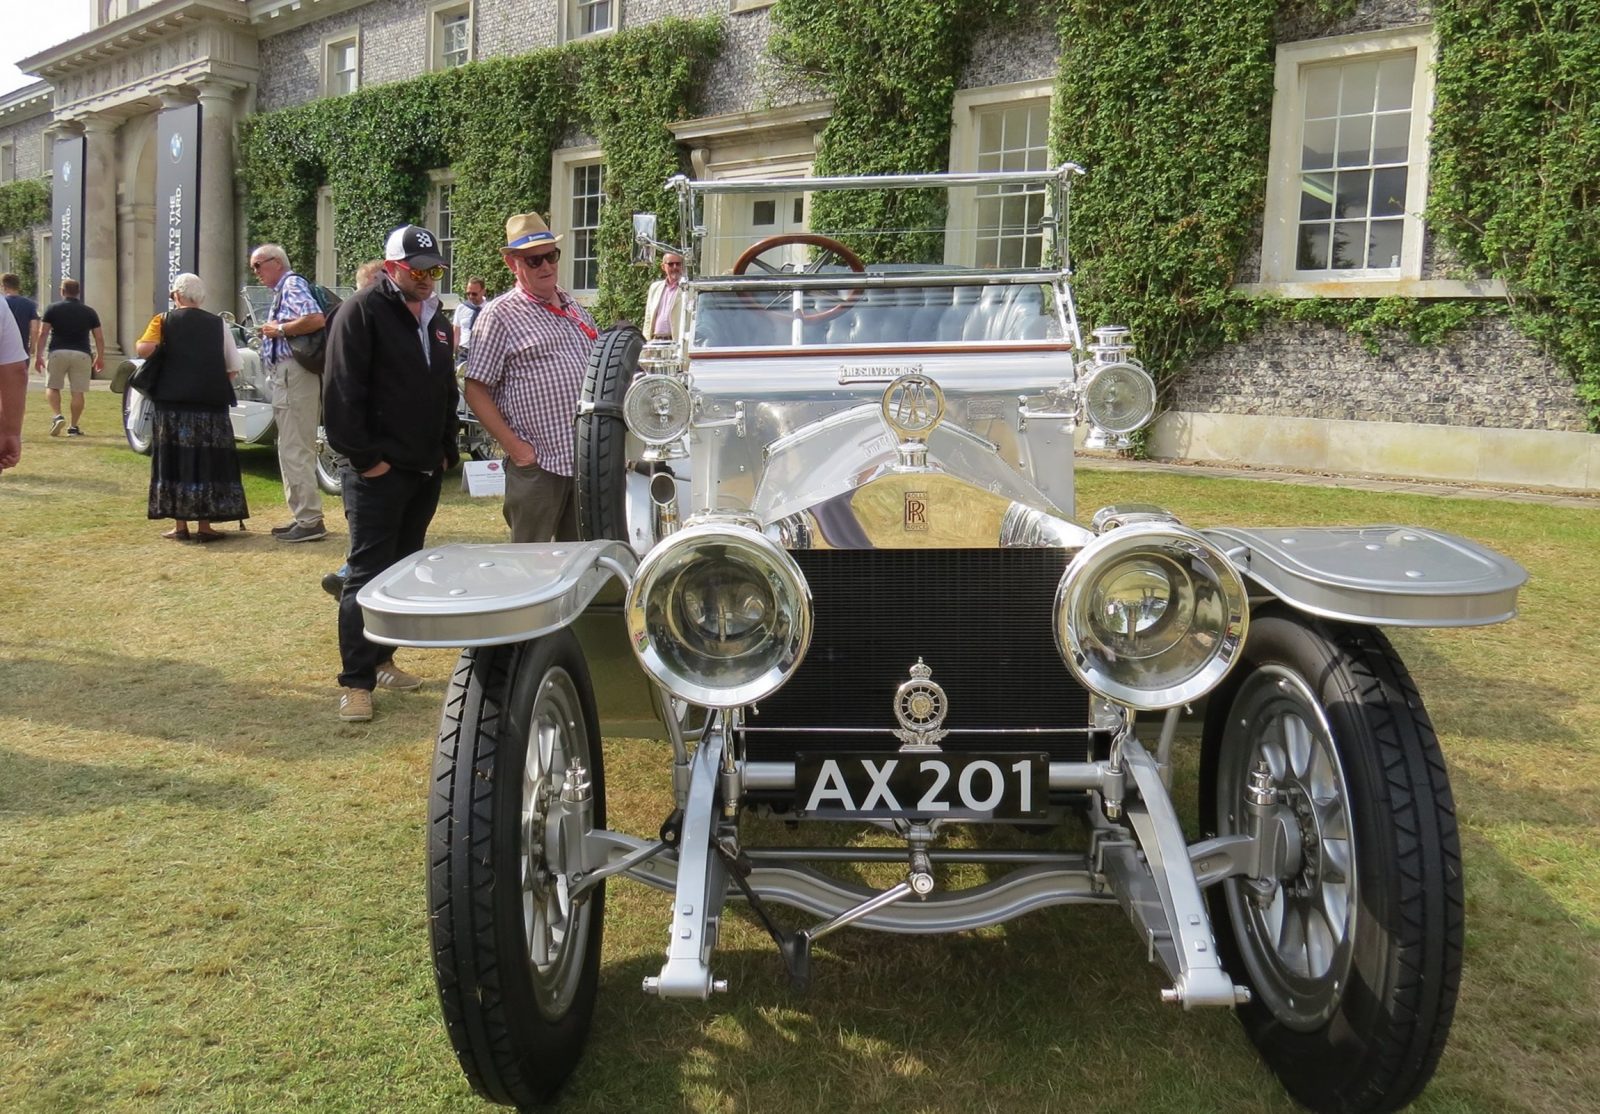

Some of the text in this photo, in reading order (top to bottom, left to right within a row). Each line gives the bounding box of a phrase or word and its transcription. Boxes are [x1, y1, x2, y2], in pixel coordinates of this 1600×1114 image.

[169, 227, 176, 249] TO
[805, 759, 1032, 812] AX 201
